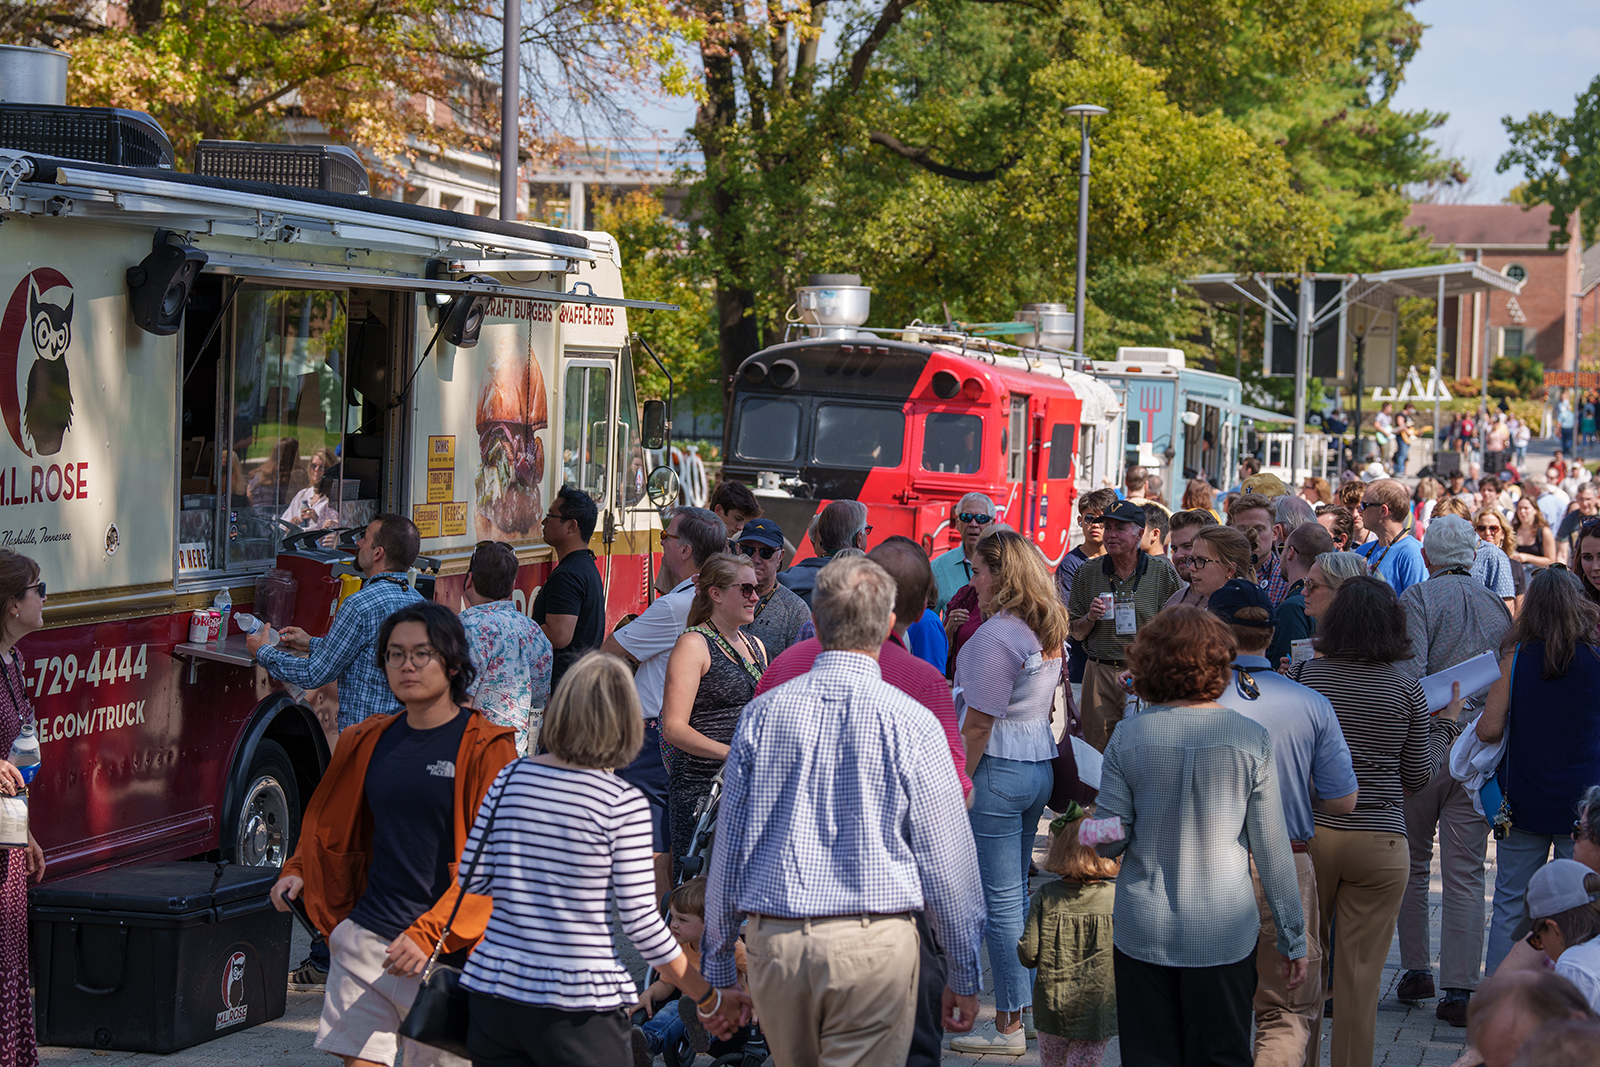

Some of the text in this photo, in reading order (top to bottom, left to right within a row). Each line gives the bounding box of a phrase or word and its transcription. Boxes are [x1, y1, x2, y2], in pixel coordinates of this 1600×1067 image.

[485, 297, 513, 318] RAFT
[514, 299, 553, 322] BURGERS
[594, 307, 615, 326] FRIES
[39, 526, 72, 544] Tennessee
[186, 548, 208, 569] HERE
